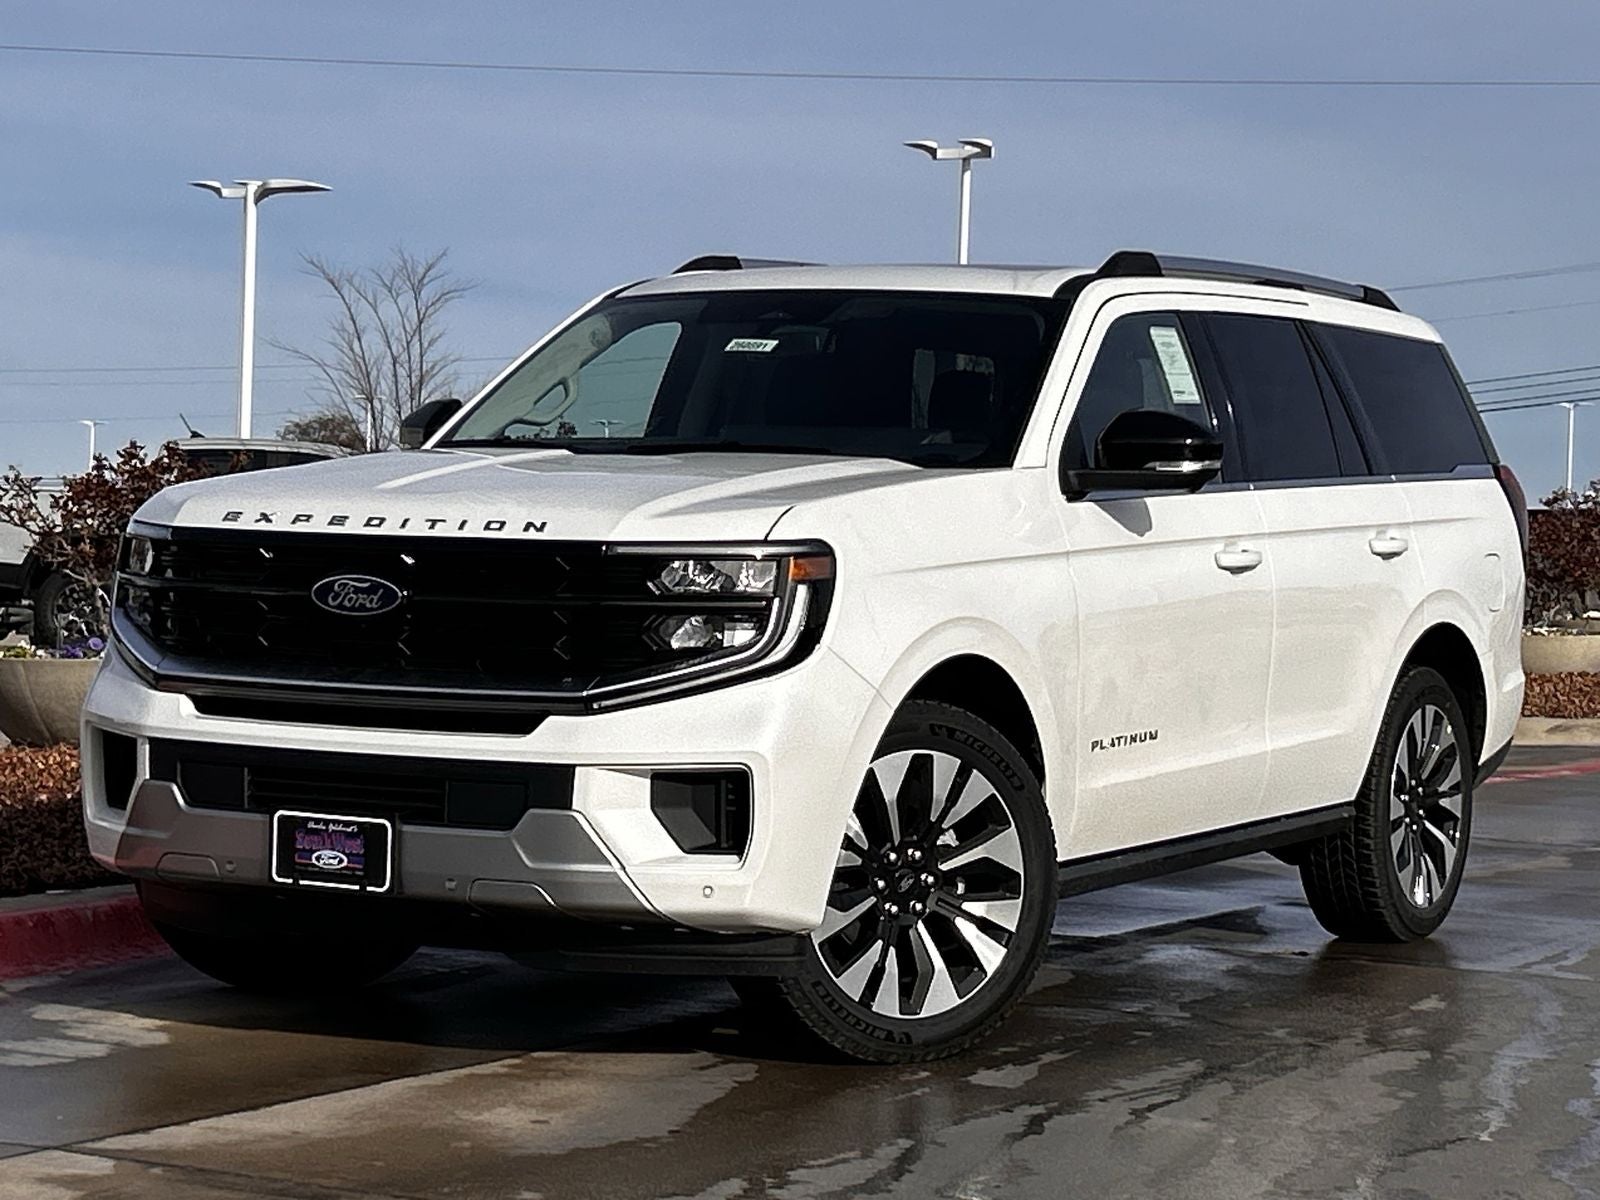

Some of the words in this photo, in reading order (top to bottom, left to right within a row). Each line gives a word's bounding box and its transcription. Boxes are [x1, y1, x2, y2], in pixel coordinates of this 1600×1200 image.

[221, 510, 548, 534] EXPEDITION
[328, 579, 384, 608] Ford
[1090, 729, 1158, 752] PLATINUM
[953, 728, 1023, 790] MICHELIN
[814, 983, 889, 1041] MICHELIN
